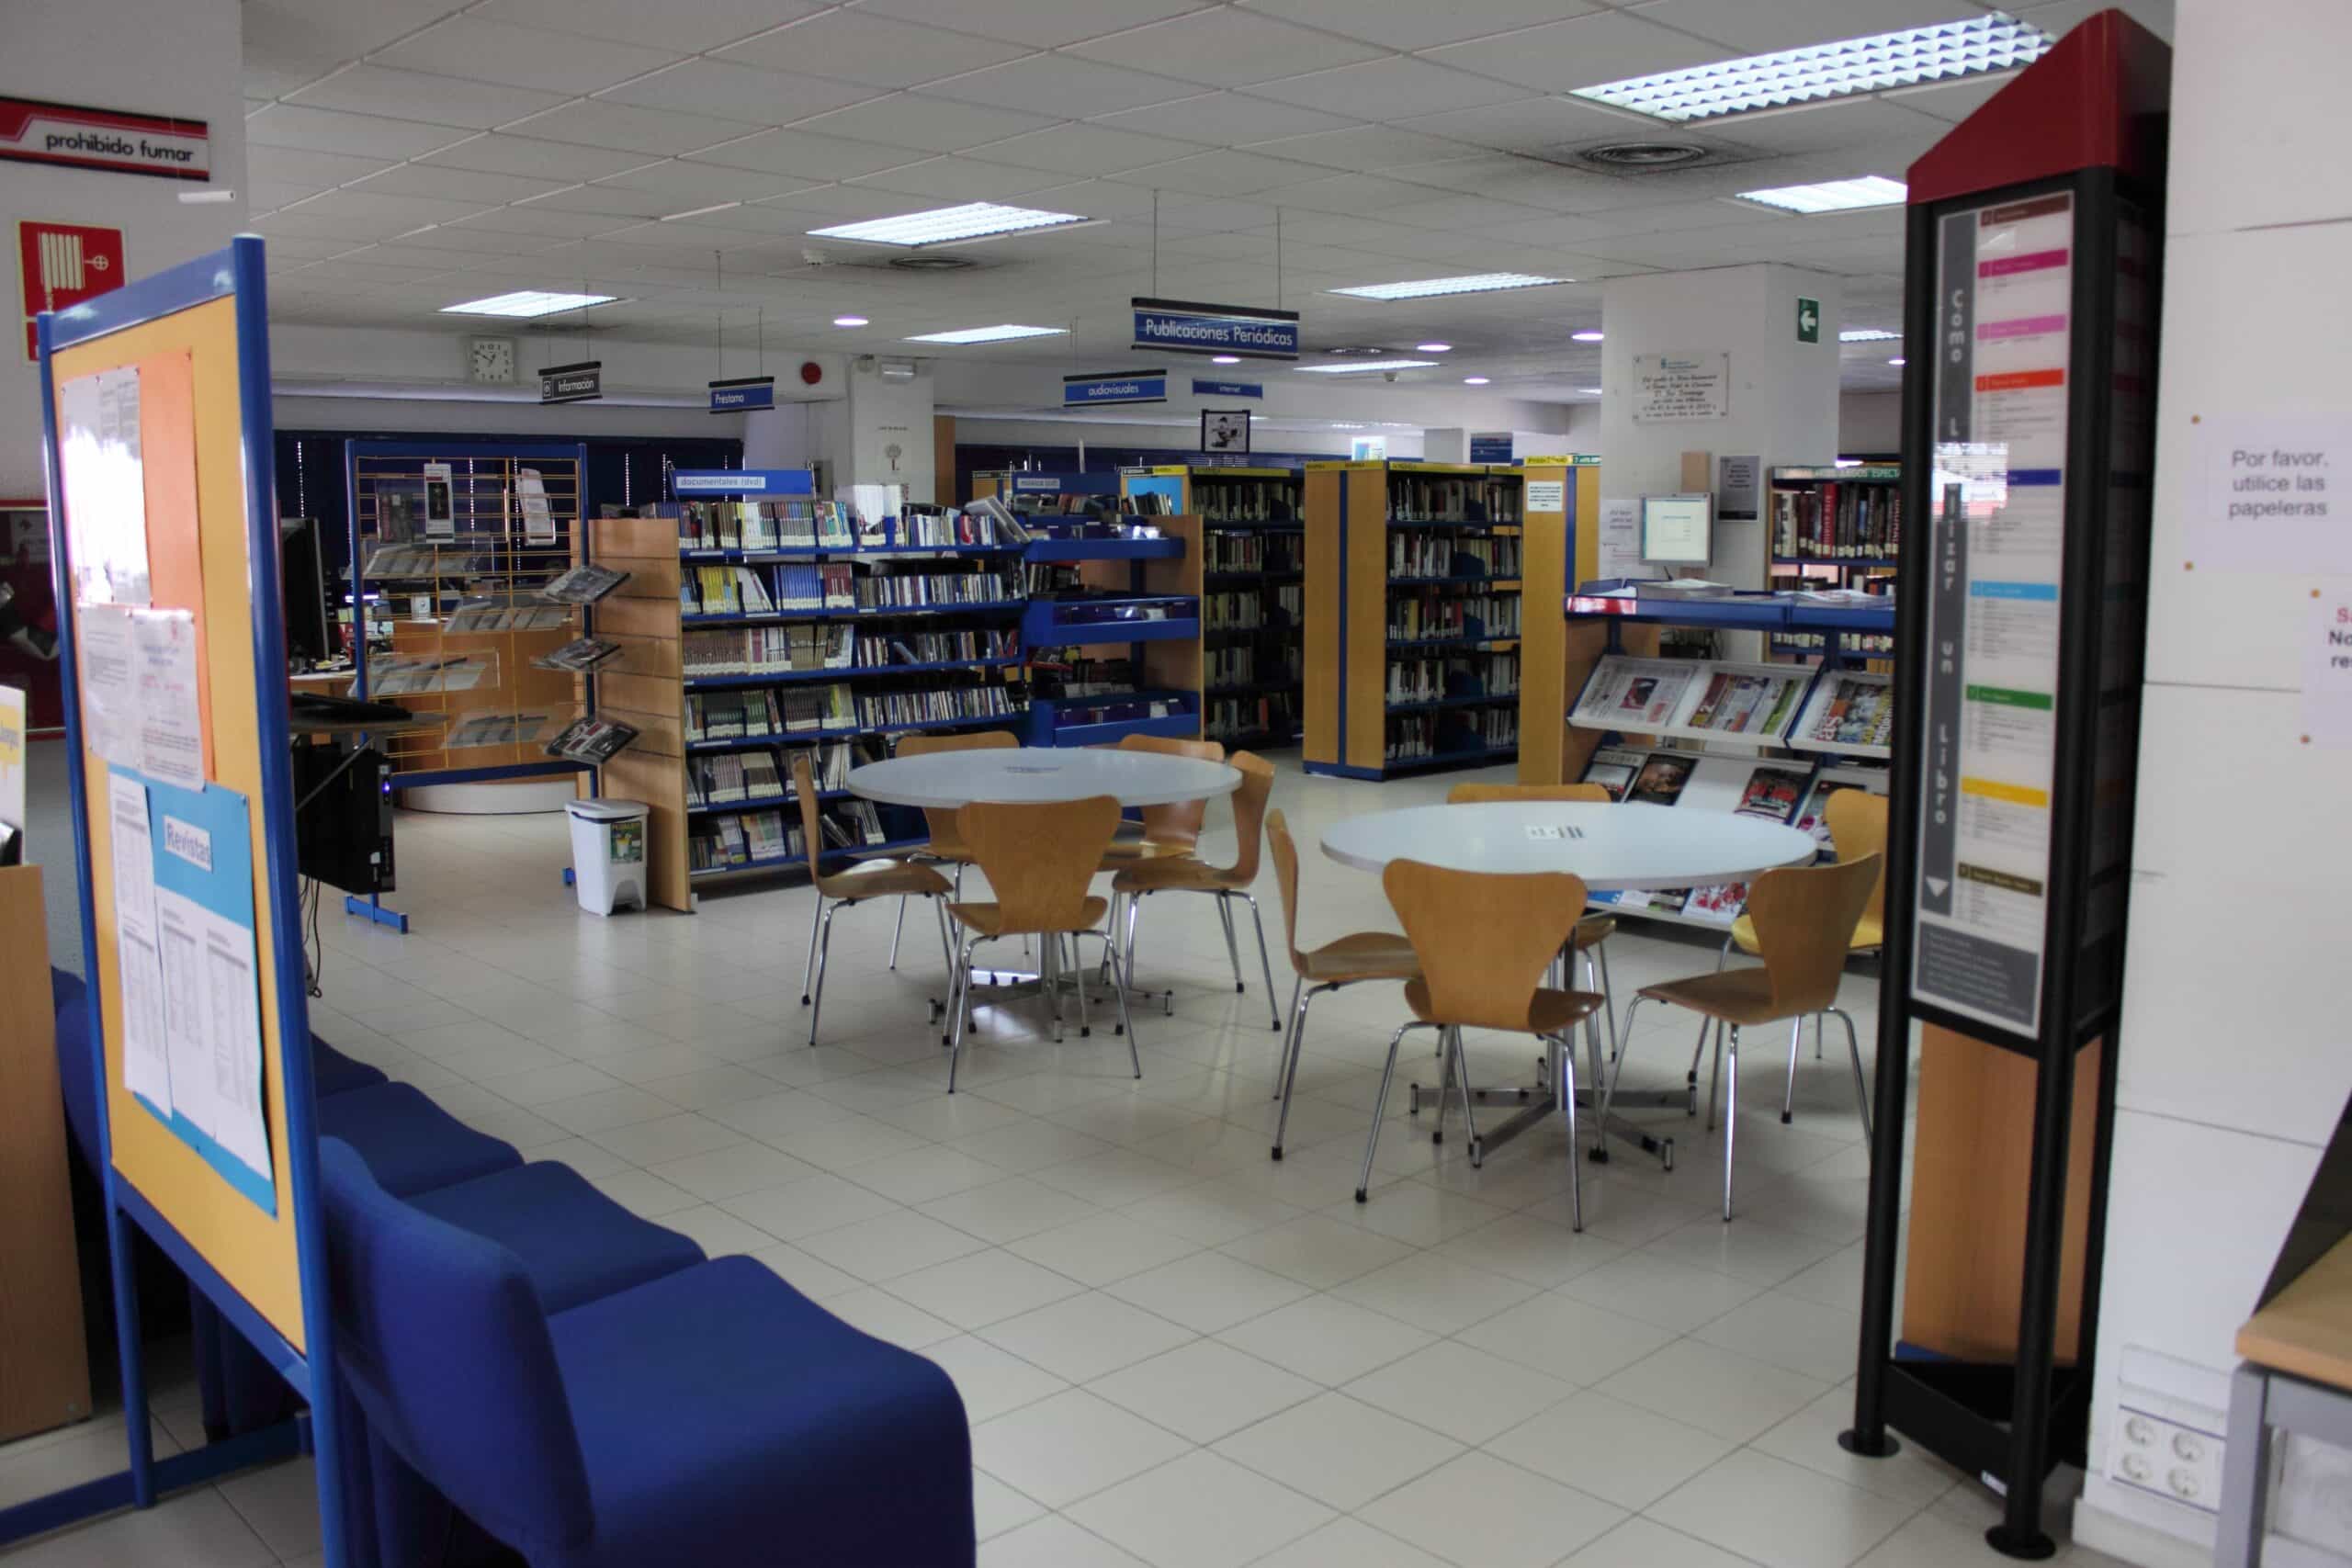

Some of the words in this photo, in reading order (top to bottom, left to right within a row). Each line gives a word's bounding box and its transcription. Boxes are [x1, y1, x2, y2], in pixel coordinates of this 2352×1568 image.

[46, 132, 133, 155] prohibido
[141, 140, 194, 163] fumar
[1146, 318, 1229, 341] Publicaciones
[1234, 326, 1293, 346] Periódicas
[1088, 382, 1139, 396] audiovisuales
[2232, 450, 2266, 468] Por
[681, 477, 738, 487] documentales
[2233, 476, 2290, 492] utilice
[2296, 475, 2325, 492] las
[2228, 501, 2328, 520] papeleras
[167, 822, 210, 864] Revistas
